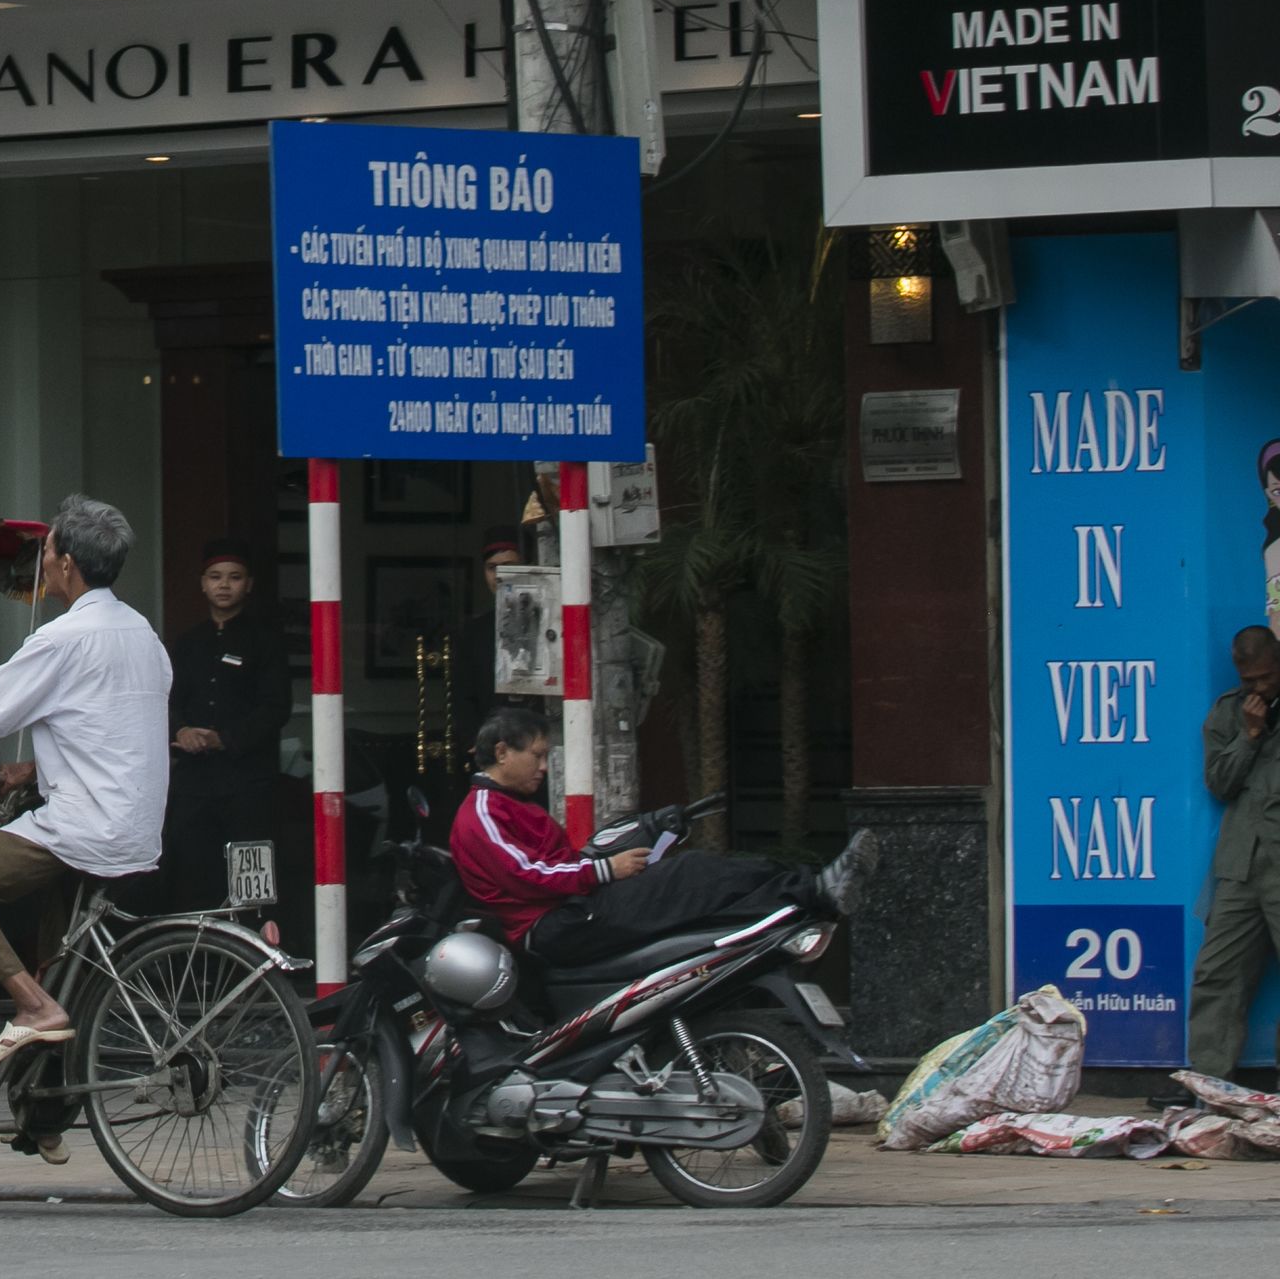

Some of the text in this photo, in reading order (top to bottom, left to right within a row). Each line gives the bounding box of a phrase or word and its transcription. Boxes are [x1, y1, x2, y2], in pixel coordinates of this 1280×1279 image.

[226, 25, 425, 93] ERA
[464, 0, 773, 79] HEL
[952, 2, 1120, 48] MADE IN
[920, 56, 1159, 116] VIETNAM
[368, 151, 554, 214] THÔNG BÁO
[301, 225, 329, 265] CÁC
[331, 224, 374, 266] TUYẾN
[376, 225, 405, 267] PHỐ
[406, 236, 422, 267] ĐI
[424, 230, 443, 276] BỘ
[444, 237, 481, 269] XUNG
[483, 238, 528, 273] QUANH
[549, 232, 586, 273] HOÀN
[587, 233, 622, 273] KIẾM
[301, 281, 616, 332] CÁC PHƯƠNG TIỆN KHÔNG ĐƯỢC PHÉP LƯU THÔNG
[304, 336, 337, 376] THỜI
[338, 344, 373, 377] GIAN
[387, 337, 408, 377] TỪ
[409, 346, 450, 379] 19H00
[453, 339, 487, 379] NGÀY
[491, 340, 518, 379] THỨ
[519, 341, 545, 380] SÁU
[547, 338, 575, 380] ĐẾN
[388, 400, 432, 432] 24H00
[435, 393, 469, 433] NGÀY
[472, 390, 499, 435] CHỦ
[501, 396, 536, 442] NHẬT
[537, 395, 575, 436] HÀNG
[1029, 387, 1168, 475] MADE
[1073, 524, 1125, 608] IN
[1045, 658, 1158, 746] VIET
[238, 847, 266, 873] 29XL
[1048, 795, 1158, 881] NAM
[236, 874, 270, 900] 0034
[1065, 927, 1142, 981] 20
[1097, 993, 1130, 1012] Hữu
[1133, 993, 1177, 1012] Huân
